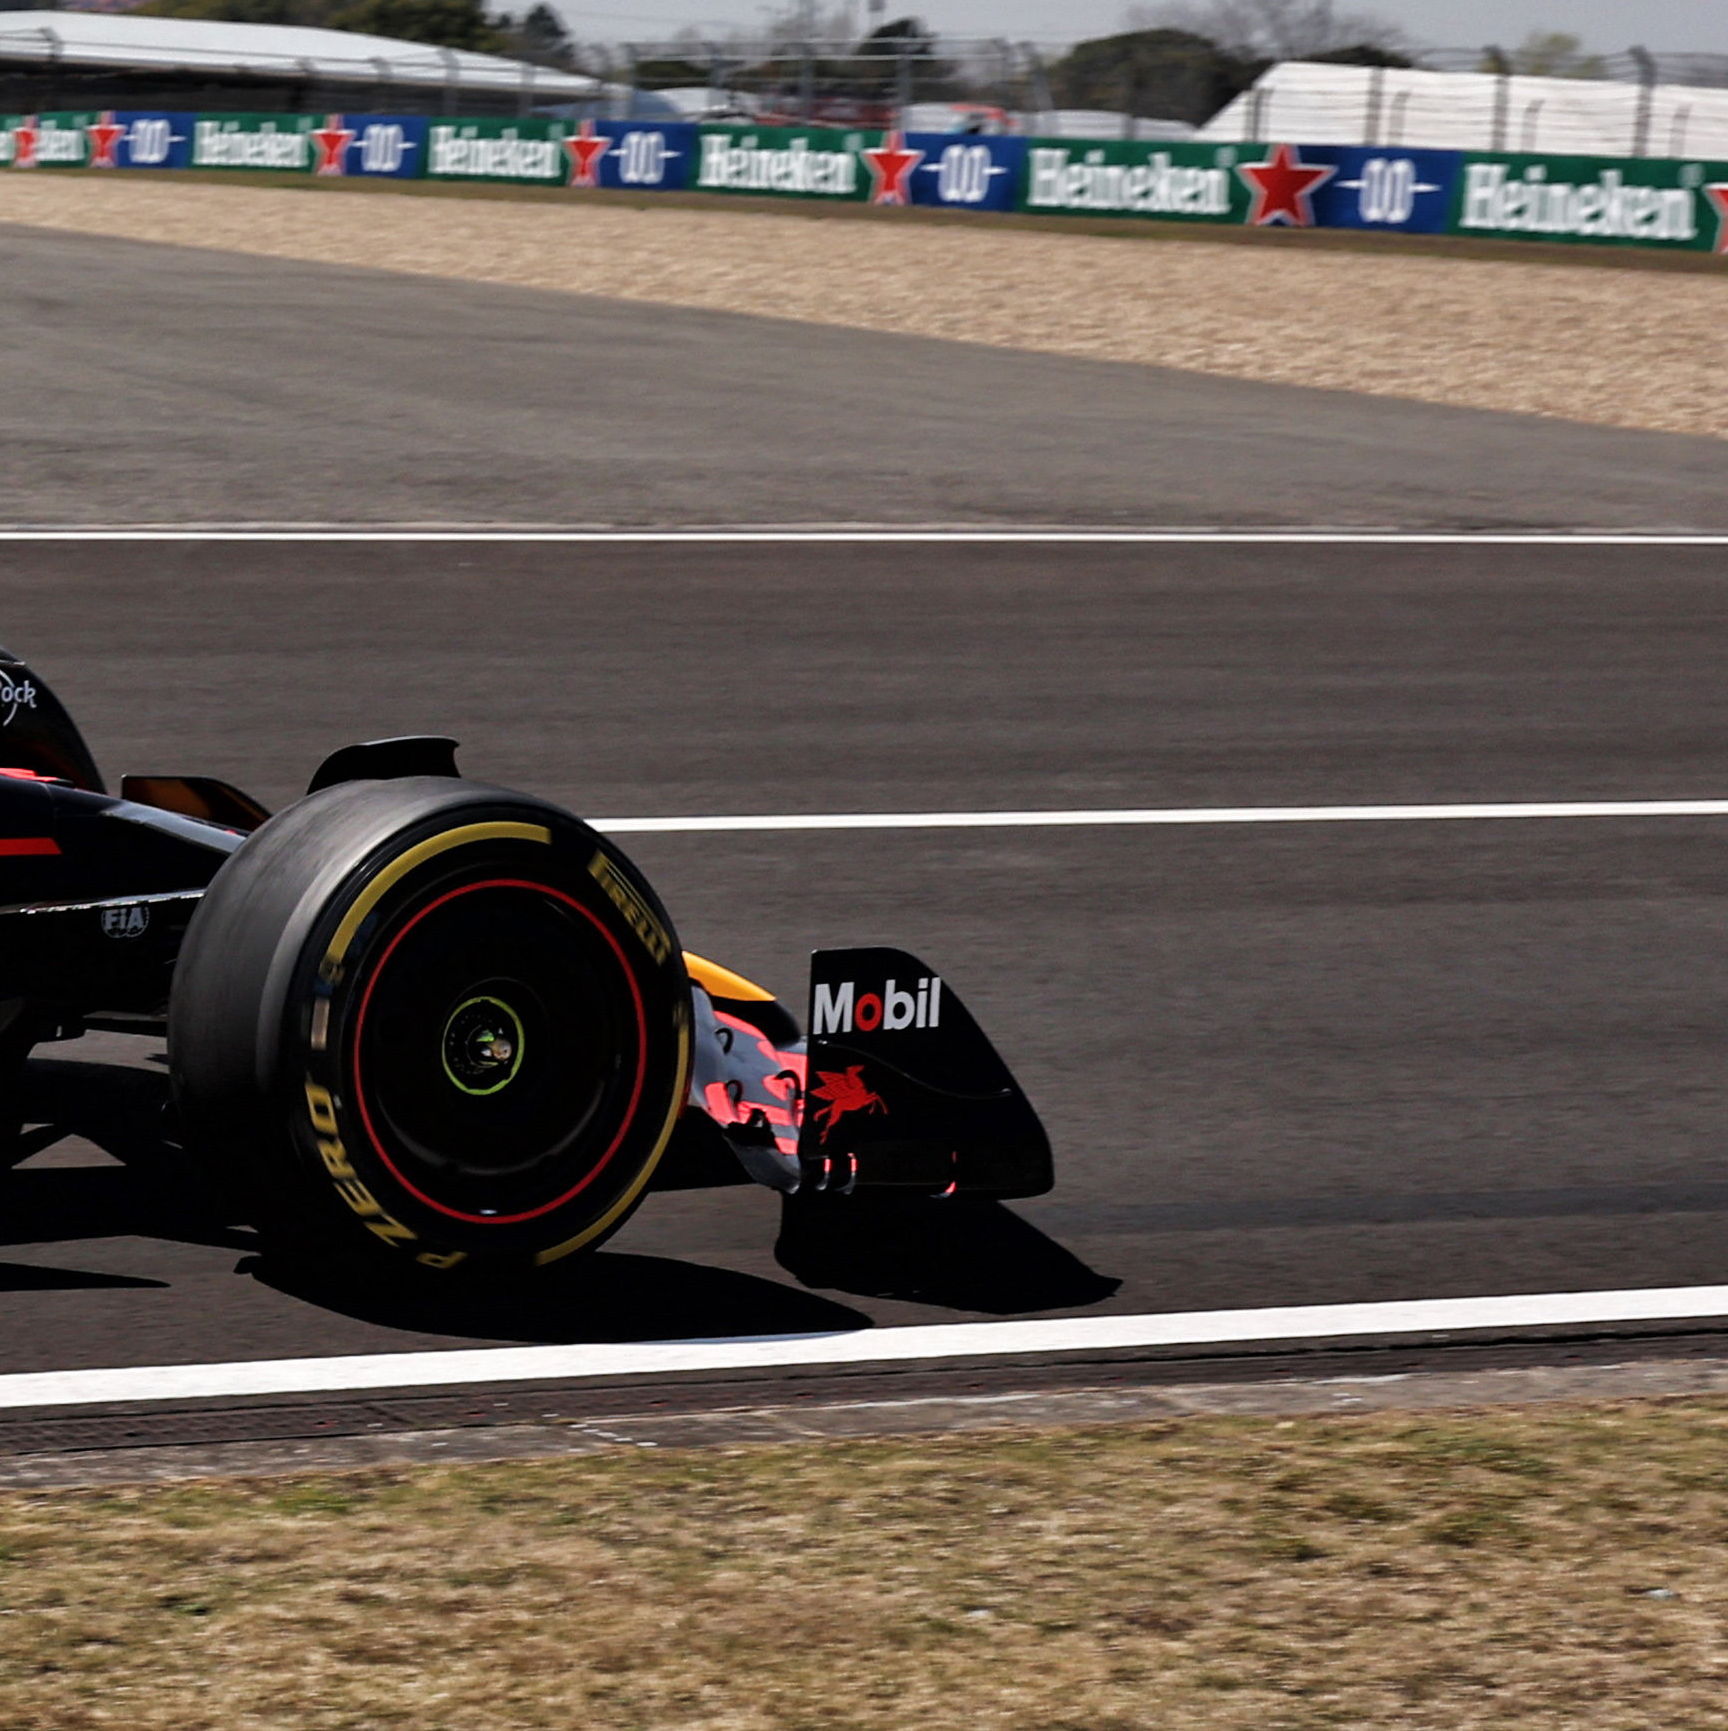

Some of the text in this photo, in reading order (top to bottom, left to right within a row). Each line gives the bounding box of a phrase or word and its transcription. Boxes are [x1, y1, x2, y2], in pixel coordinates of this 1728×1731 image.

[697, 134, 856, 193] Heineken
[1027, 148, 1231, 214] Heineken
[1460, 164, 1696, 239] Heineken
[104, 907, 144, 930] FIA
[813, 976, 941, 1035] Mobil
